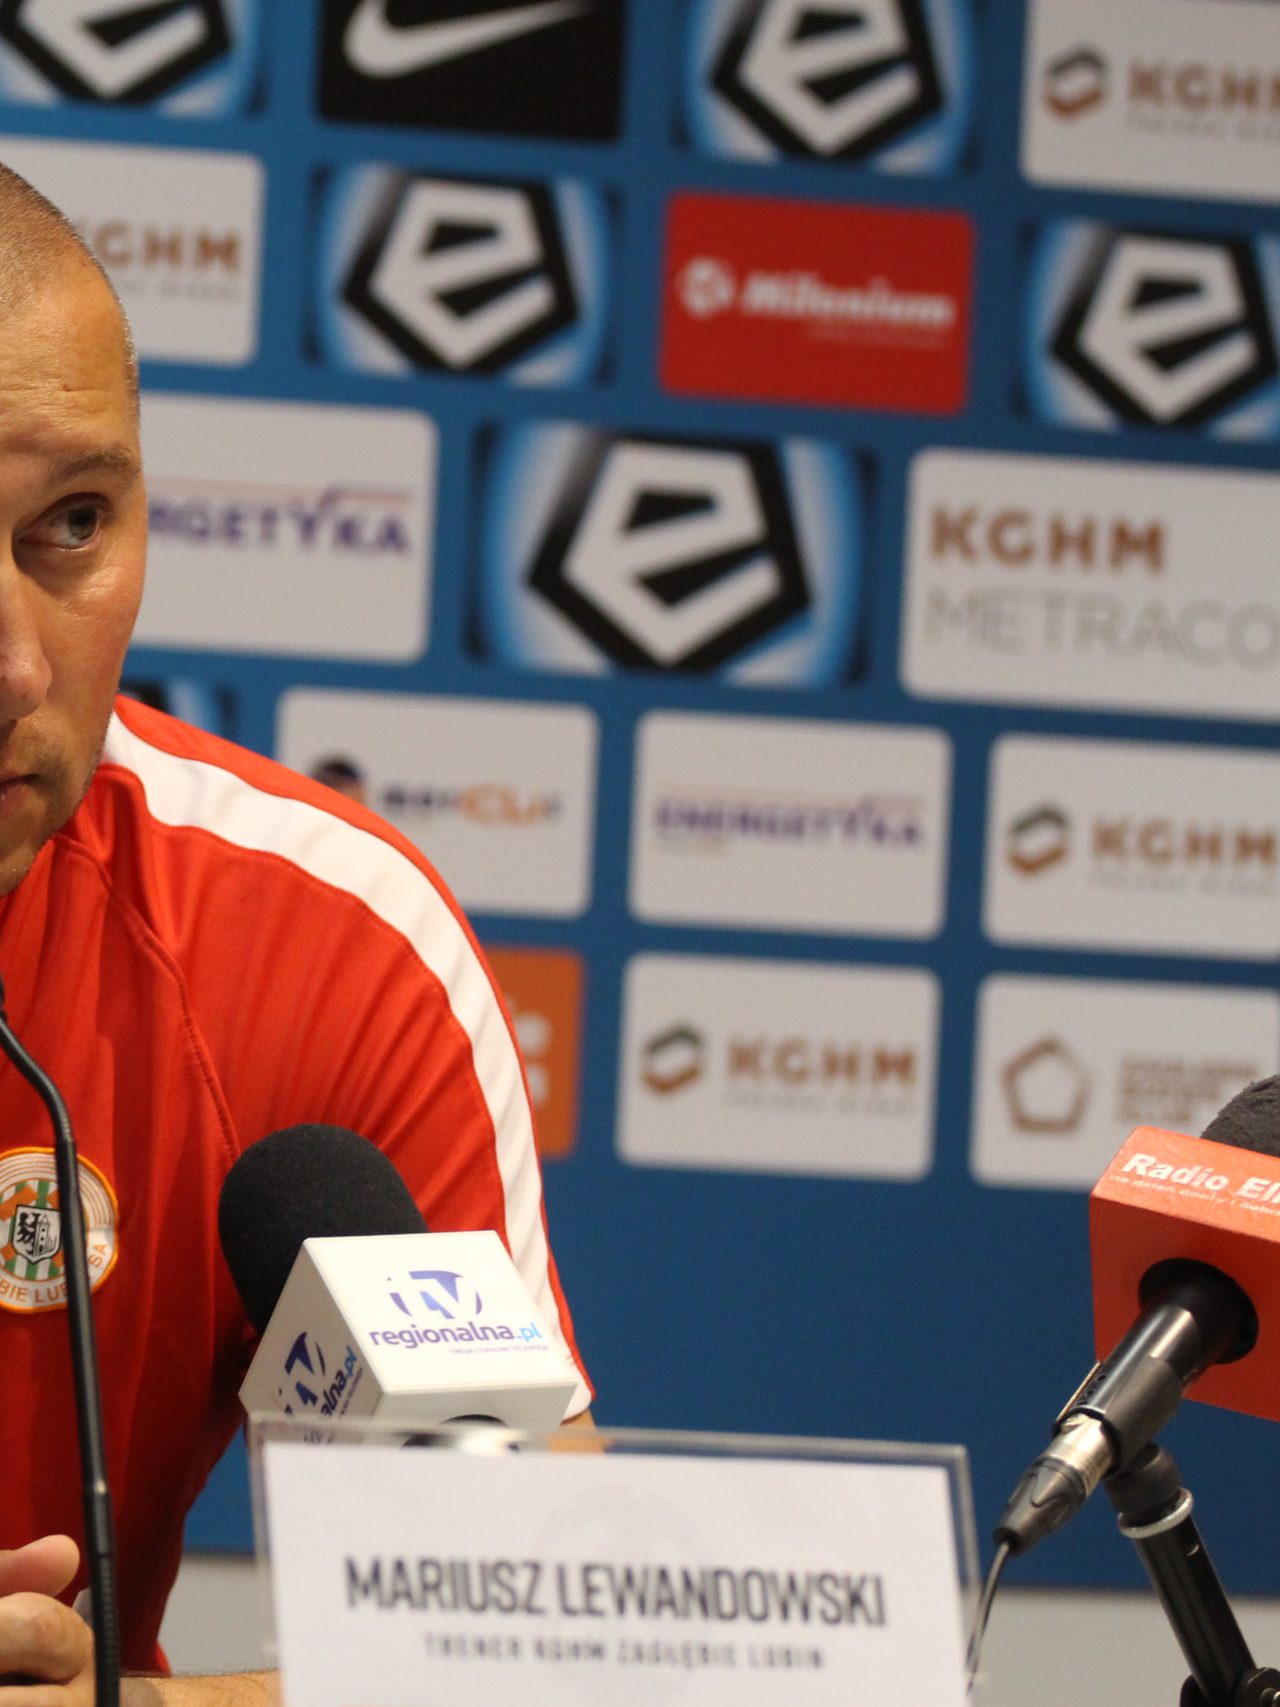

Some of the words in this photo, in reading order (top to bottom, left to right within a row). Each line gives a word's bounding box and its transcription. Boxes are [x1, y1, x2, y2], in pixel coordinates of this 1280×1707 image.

[1127, 56, 1280, 115] KGH
[76, 218, 241, 274] GHM
[928, 504, 1166, 577] KGHM
[1091, 816, 1278, 868] KGHM
[728, 1036, 916, 1088] KGHM
[1122, 1152, 1229, 1191] Radio
[369, 1321, 543, 1349] regionalna.pl
[344, 1557, 543, 1616] MARIUSZ
[557, 1563, 888, 1629] LEWANDOWSKI
[424, 1632, 522, 1663] TRENER
[748, 1643, 827, 1672] LUBIN
